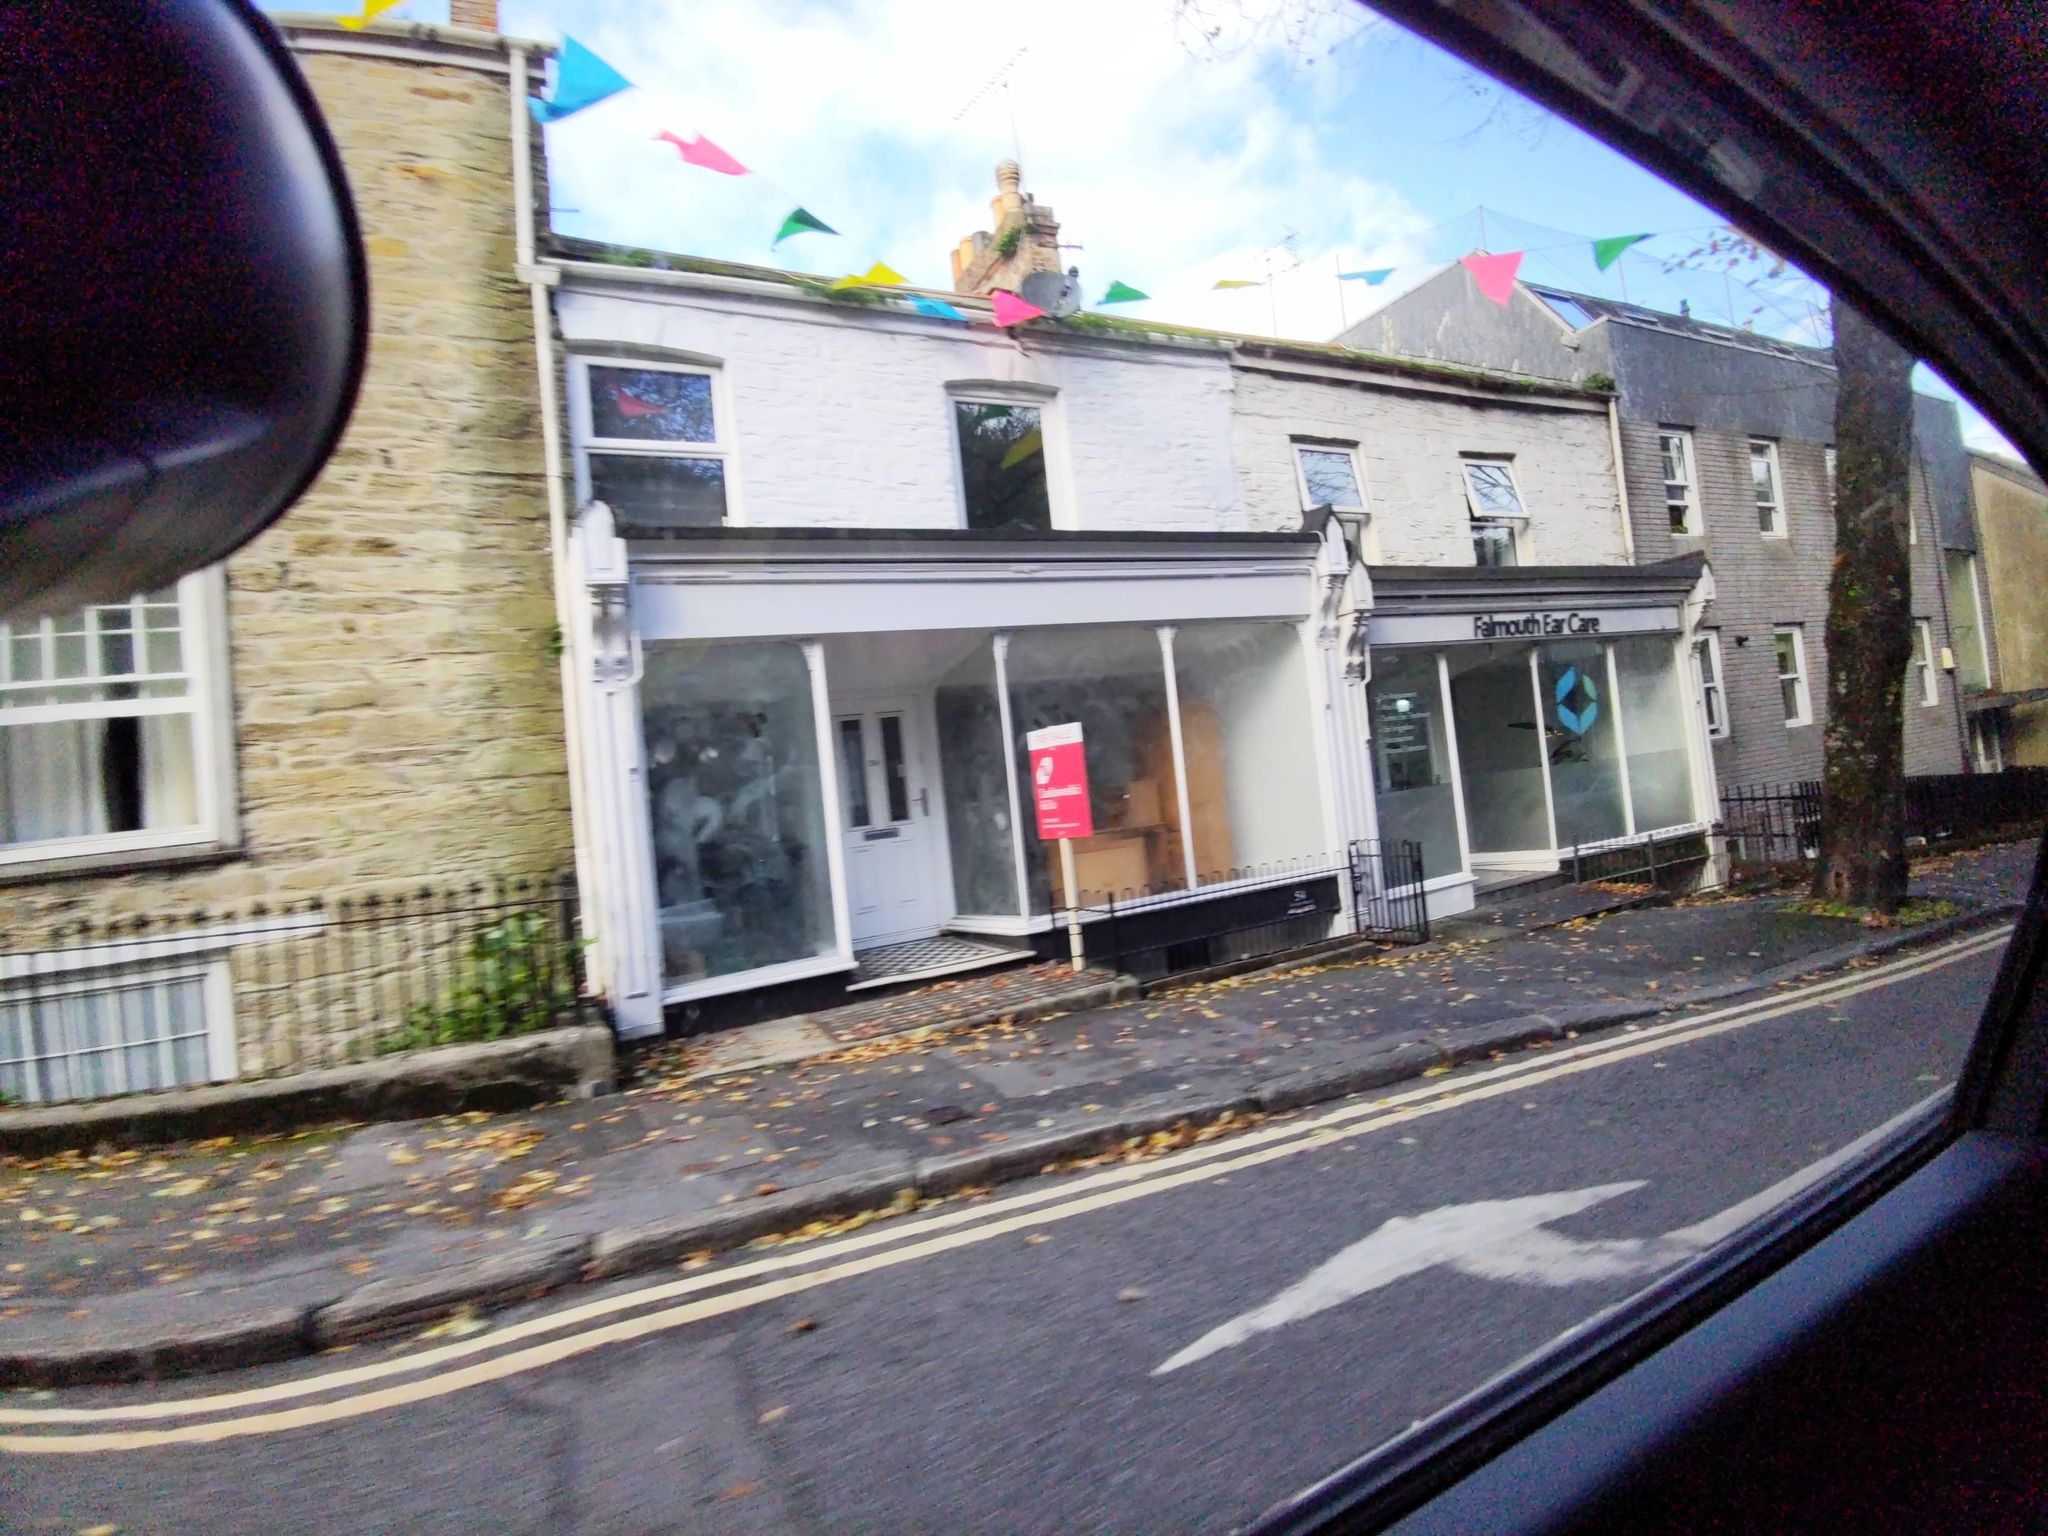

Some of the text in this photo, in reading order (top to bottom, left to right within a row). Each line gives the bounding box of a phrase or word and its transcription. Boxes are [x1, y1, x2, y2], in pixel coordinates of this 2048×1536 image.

[1474, 612, 1600, 637] Falmouth Ear Care
